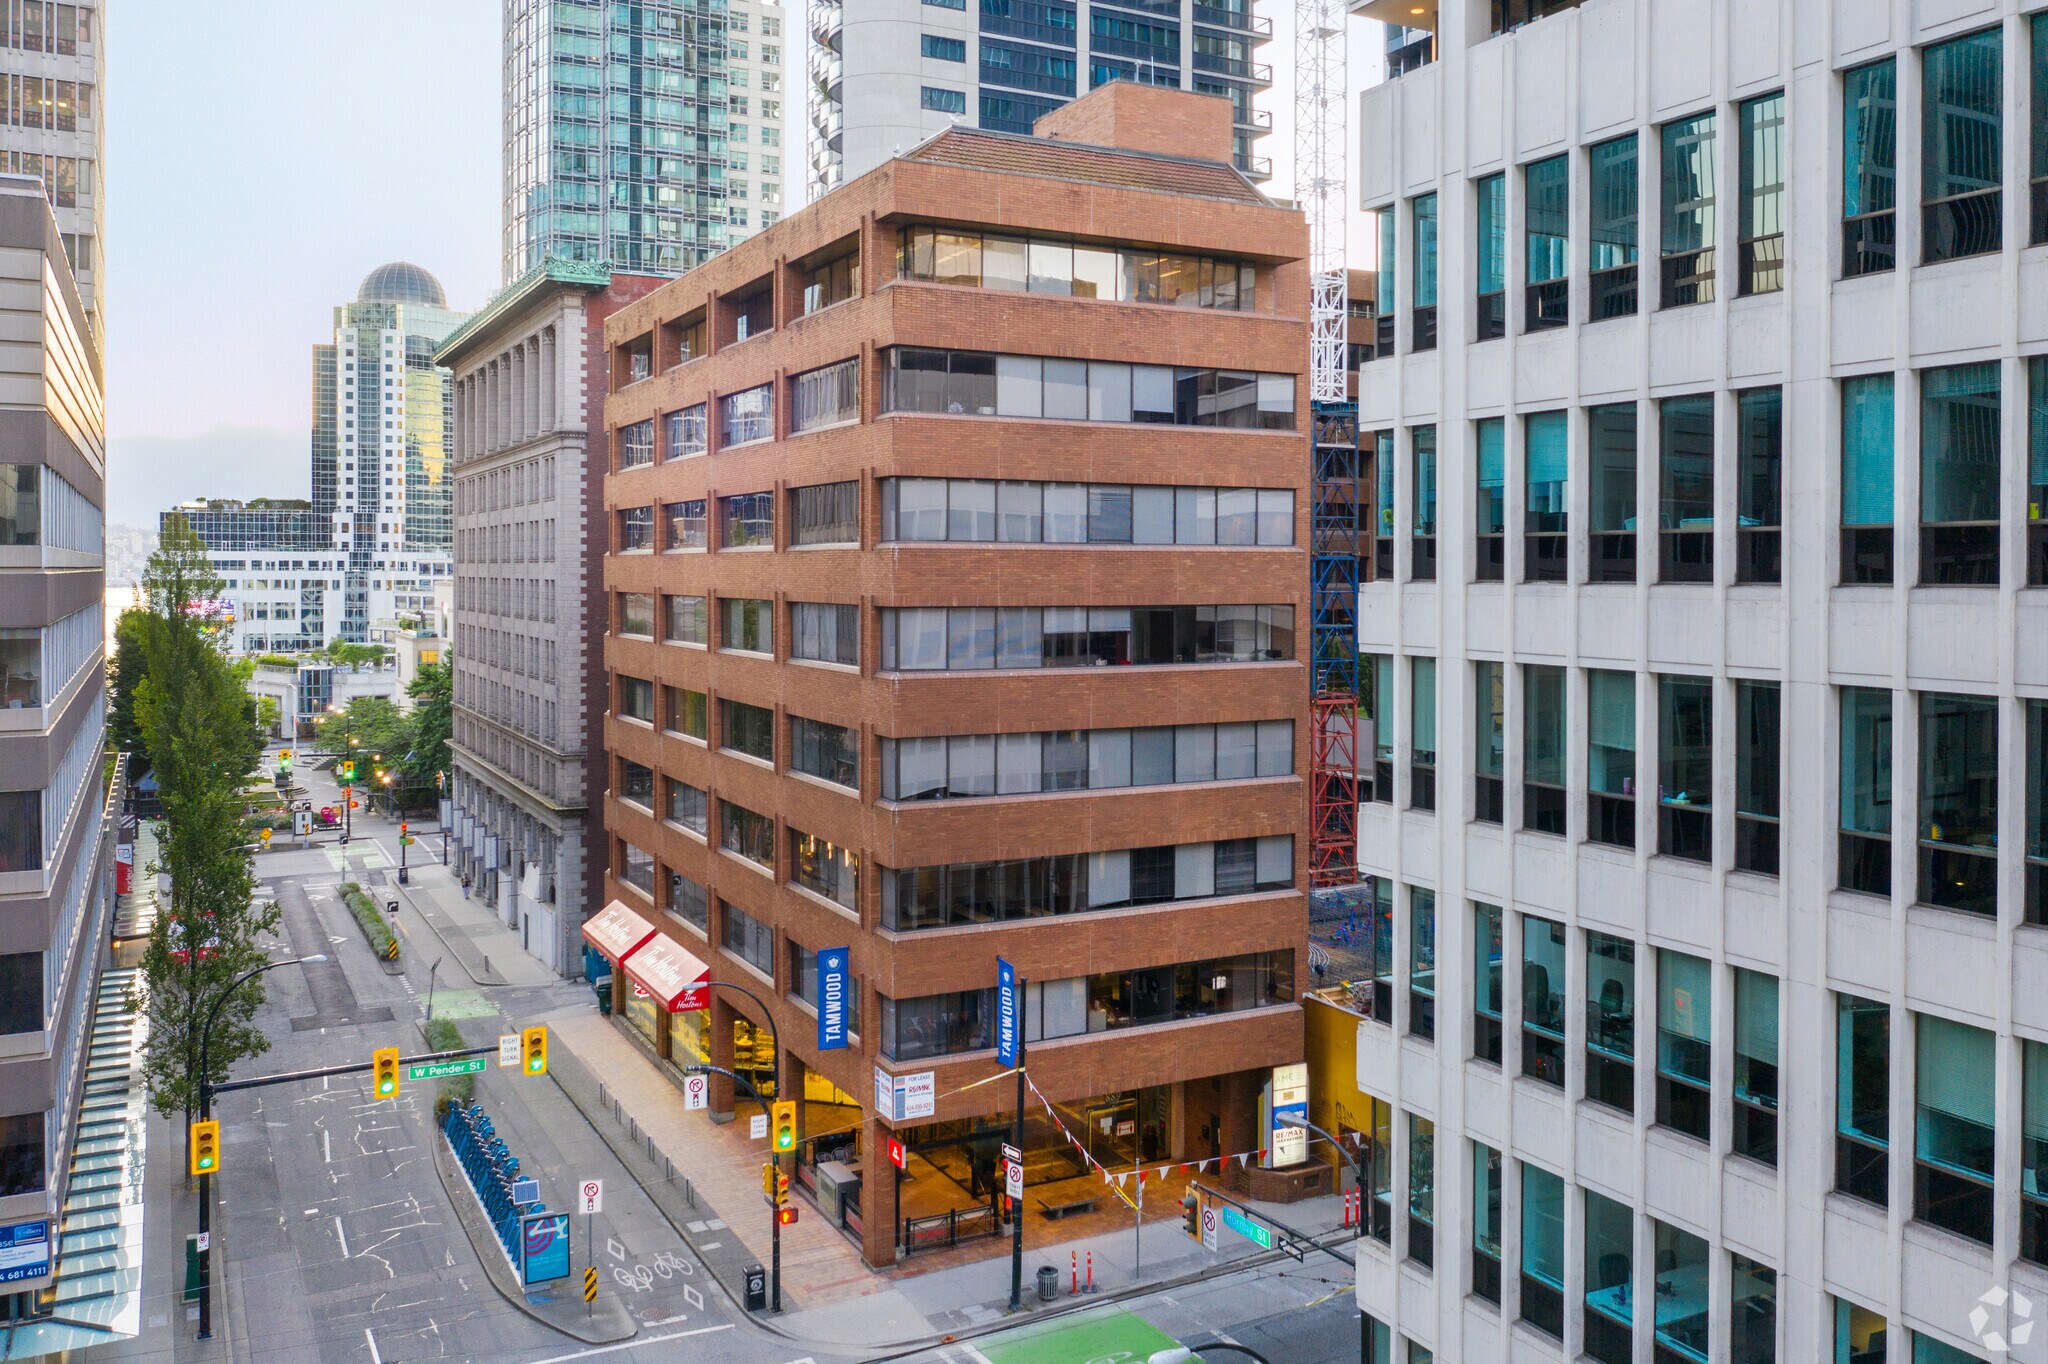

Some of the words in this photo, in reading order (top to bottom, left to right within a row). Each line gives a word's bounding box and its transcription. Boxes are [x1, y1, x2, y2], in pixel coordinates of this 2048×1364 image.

[596, 910, 618, 930] Tim
[639, 945, 665, 967] Tim
[676, 1000, 703, 1009] Hortons
[684, 993, 697, 1001] Tim
[826, 973, 841, 1042] TAMWOOD
[1002, 986, 1013, 1058] TAMWOOD
[415, 1068, 425, 1077] W
[429, 1065, 465, 1075] Pender
[469, 1062, 480, 1071] St
[1276, 1129, 1303, 1139] RE/MAX
[1226, 1211, 1254, 1237] Hornby
[1256, 1229, 1267, 1243] St
[8, 1270, 24, 1280] 681
[27, 1266, 46, 1276] 4111
